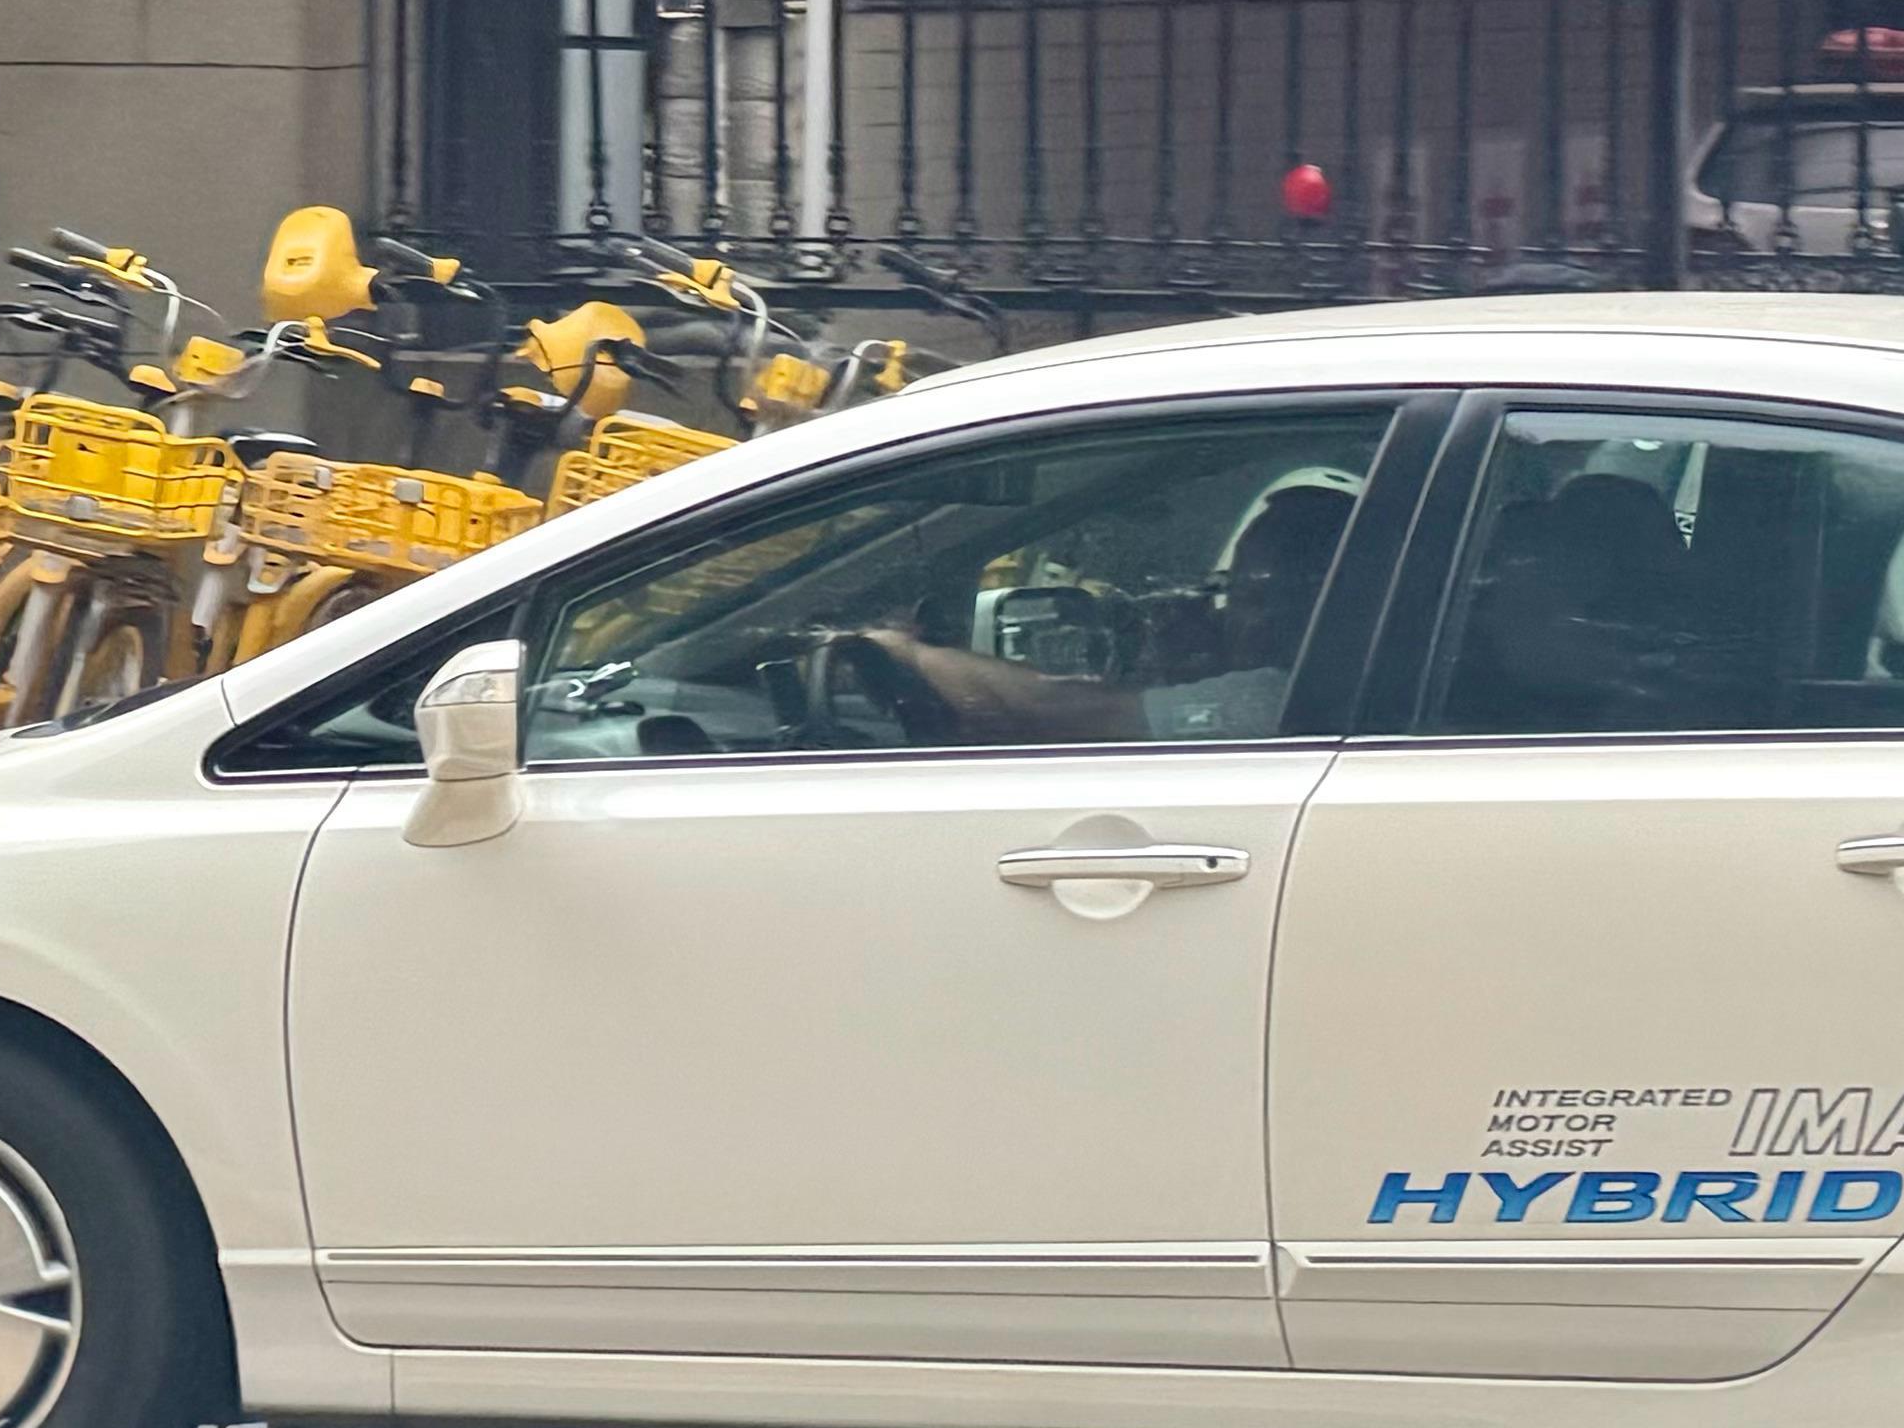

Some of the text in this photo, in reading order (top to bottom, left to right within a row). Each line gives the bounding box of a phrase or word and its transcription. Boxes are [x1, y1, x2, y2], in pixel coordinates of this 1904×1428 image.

[1492, 1088, 1732, 1108] INTEGRATED
[1487, 1113, 1617, 1134] MOTOR
[1481, 1138, 1614, 1158] ASSIST
[1366, 1169, 1904, 1224] HYBRID
